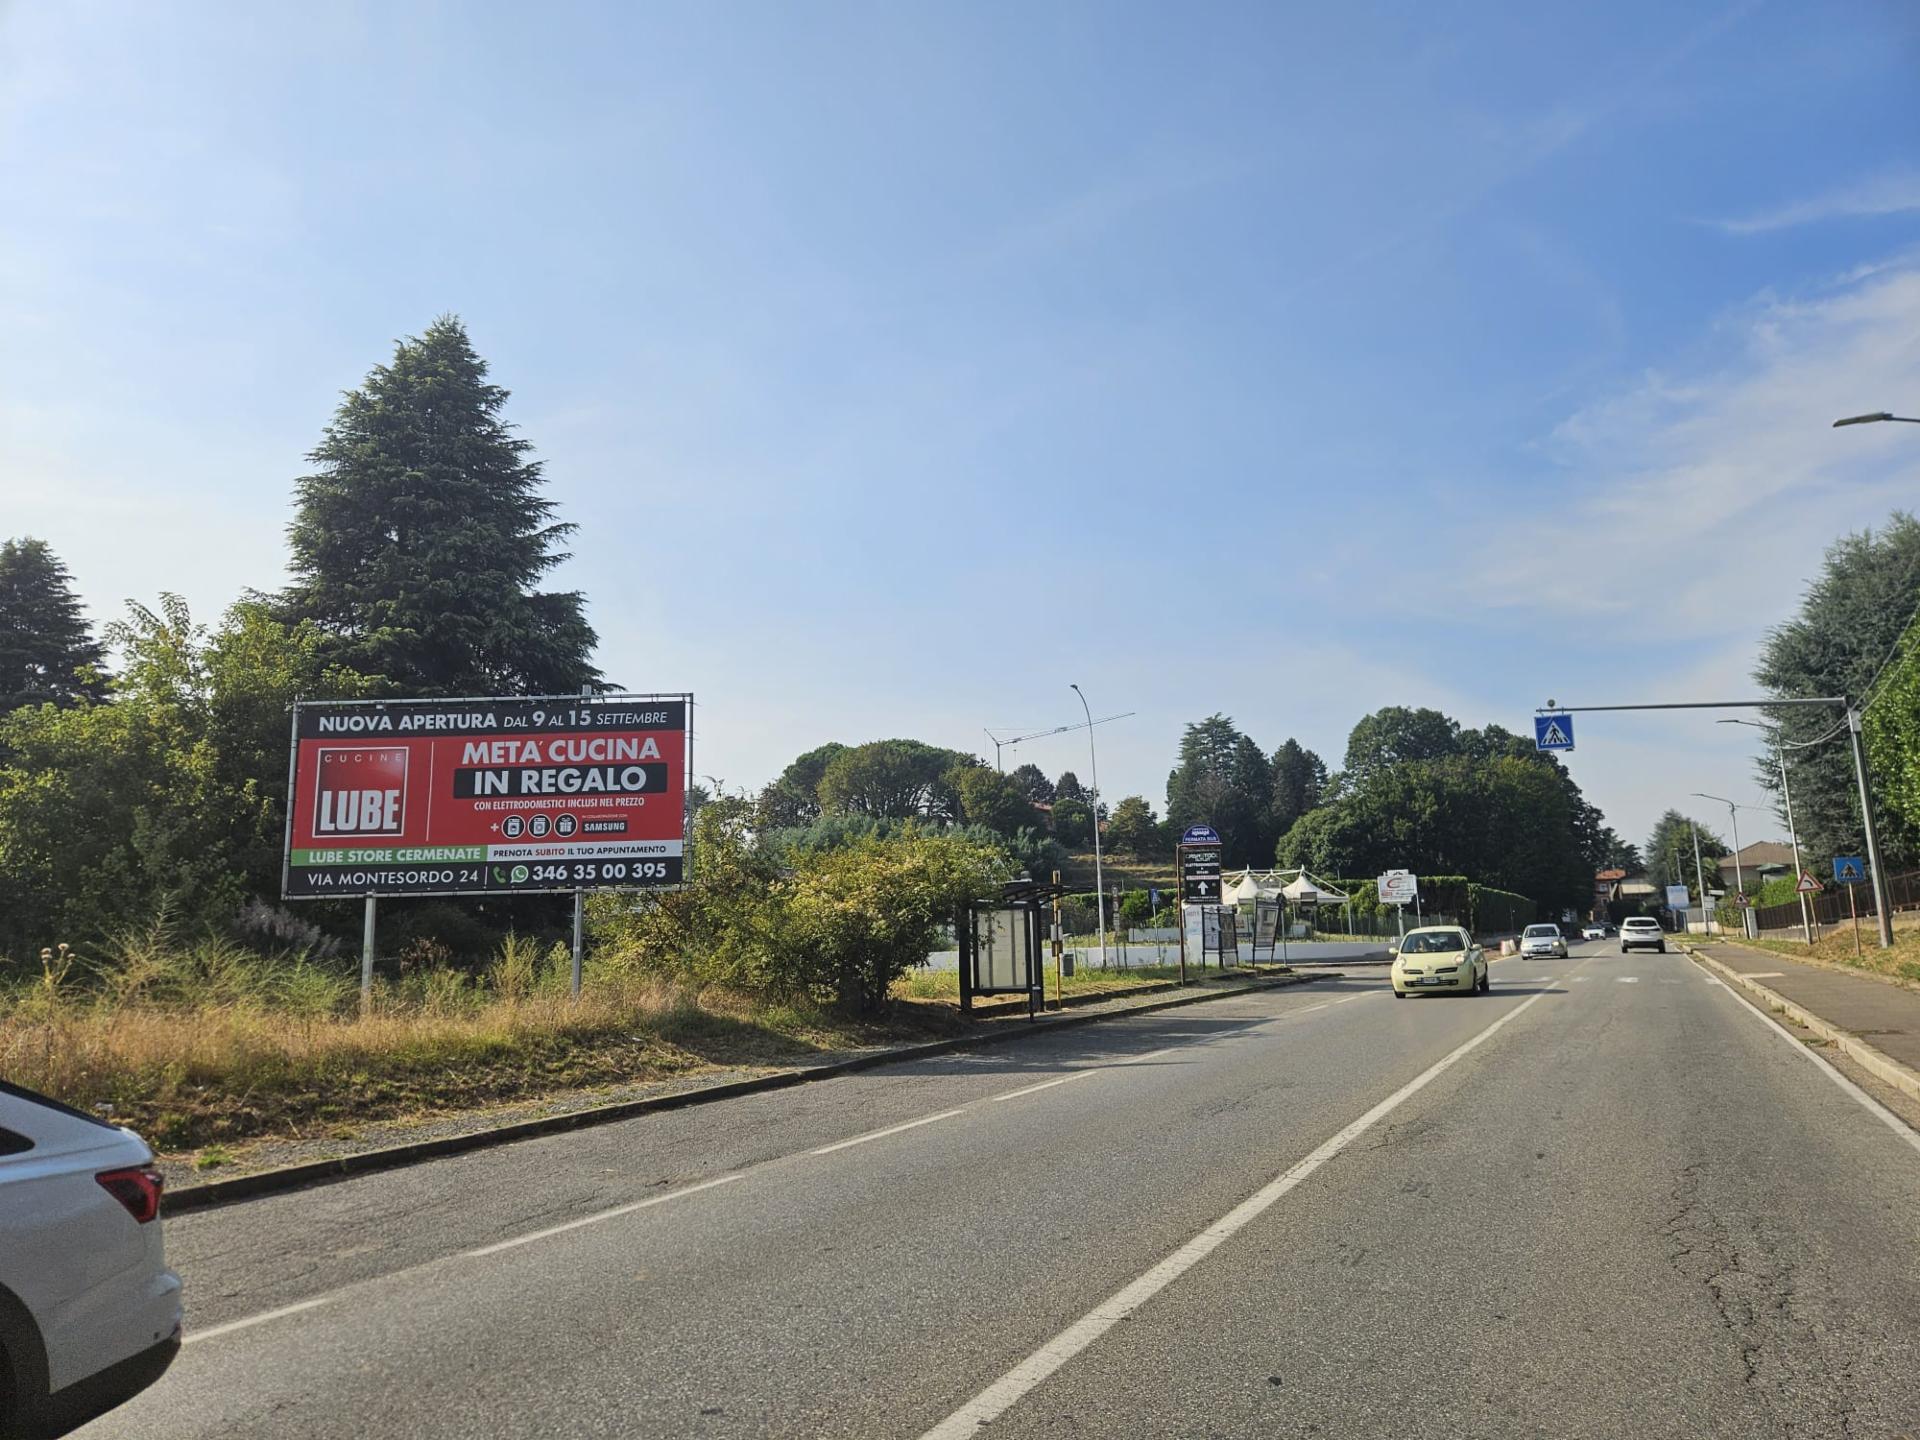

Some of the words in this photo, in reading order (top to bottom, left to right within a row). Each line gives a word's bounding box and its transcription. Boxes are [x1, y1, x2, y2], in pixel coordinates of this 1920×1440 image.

[319, 716, 392, 732] NUOVA
[399, 713, 496, 730] APERTURA
[504, 716, 528, 728] DAL
[532, 711, 544, 727] 9
[548, 715, 564, 726] AL
[568, 710, 591, 726] 15
[596, 712, 667, 725] SETTEMBRE
[548, 737, 660, 762] CUCINA
[325, 754, 401, 762] CUCINE
[474, 770, 509, 795] IN
[521, 766, 647, 793] REGALO
[321, 789, 400, 831] LUBE
[474, 800, 491, 811] CON
[493, 799, 566, 810] ELETTRODOMESTICI
[567, 798, 598, 808] INCLUSI
[600, 797, 613, 807] NEL
[615, 797, 644, 807] PREZZO
[584, 822, 625, 832] SAMSUNG
[308, 850, 345, 863] LUBE
[349, 848, 393, 862] STORE
[397, 847, 481, 861] CERMENATE
[493, 847, 532, 857] PRENOTA
[535, 847, 565, 856] SUBITO
[568, 847, 574, 855] IL
[577, 847, 593, 855] TUO
[597, 845, 666, 855] APPUNTAMENTO
[308, 874, 333, 885] VIA
[339, 870, 453, 884] MONTESORDO
[460, 869, 478, 882] 24
[532, 864, 567, 881] 346
[573, 864, 596, 880] 35
[601, 863, 626, 879] 00
[632, 862, 666, 878] 395
